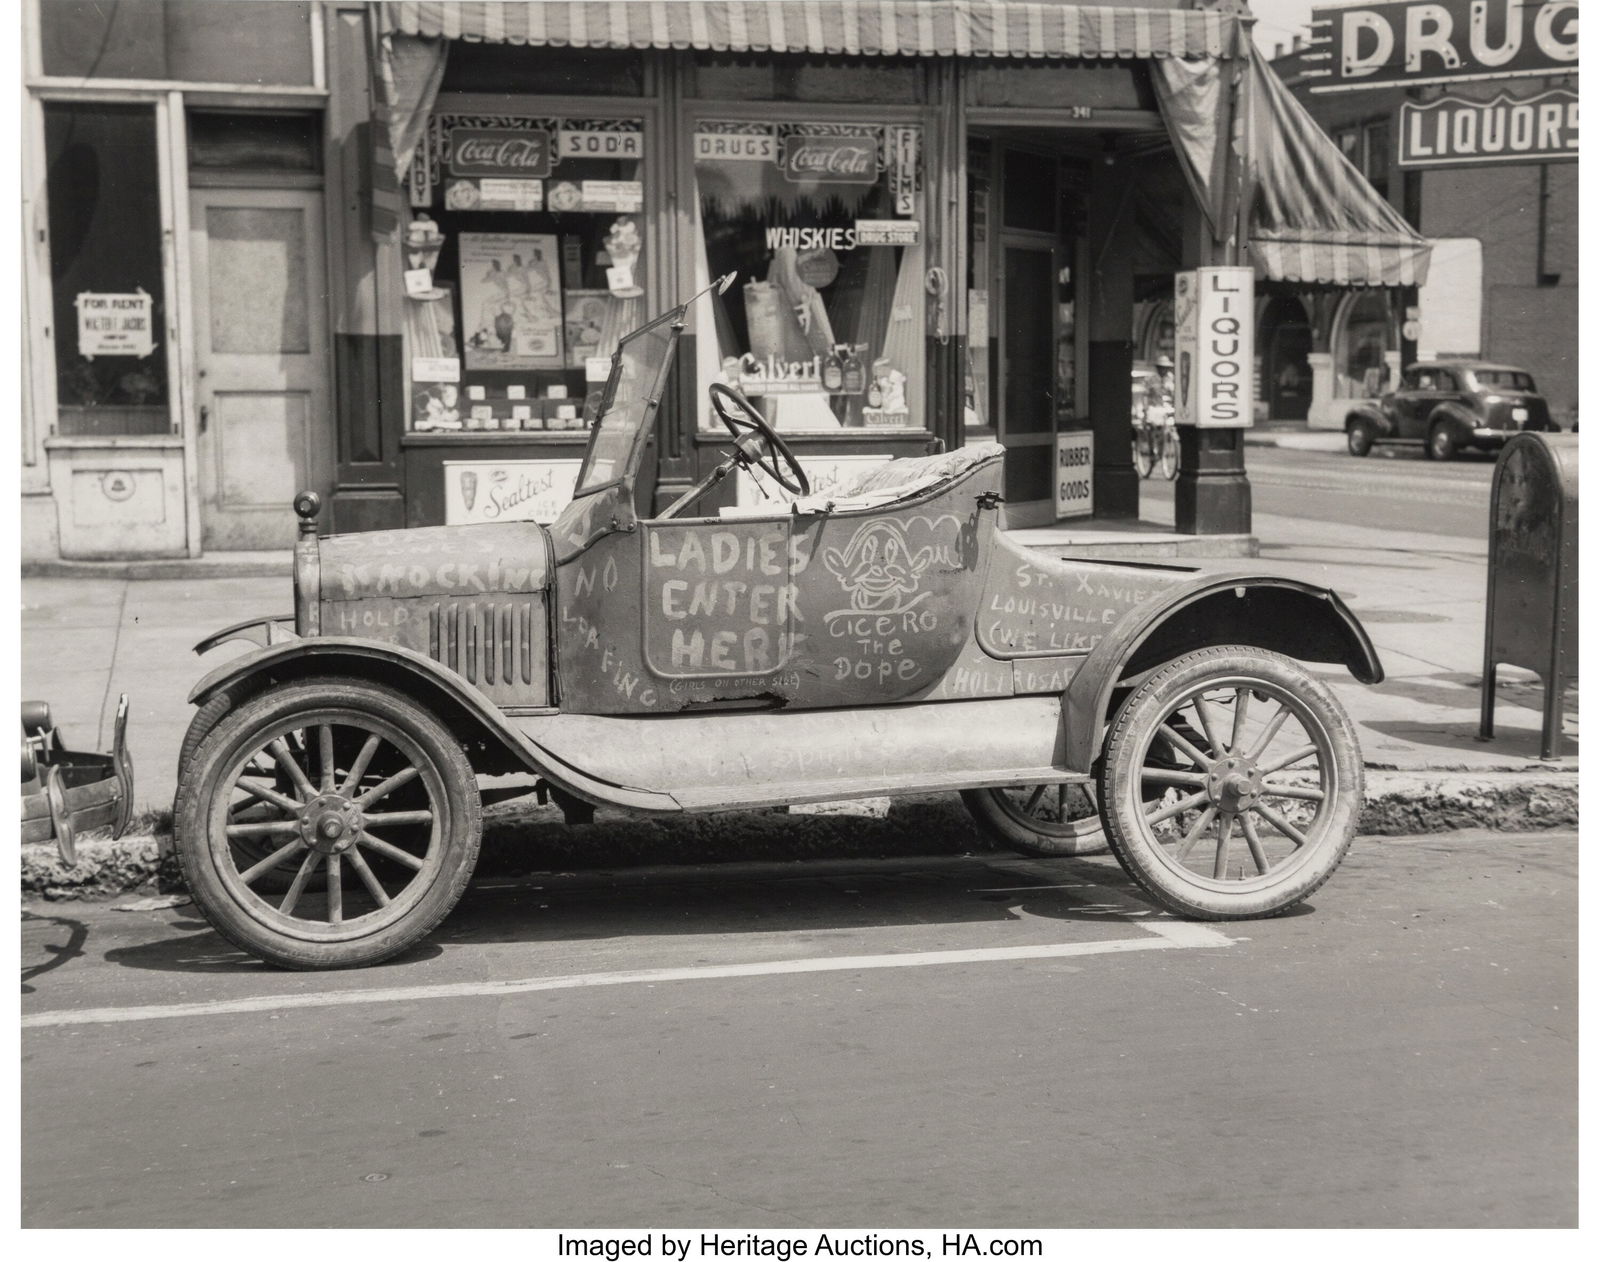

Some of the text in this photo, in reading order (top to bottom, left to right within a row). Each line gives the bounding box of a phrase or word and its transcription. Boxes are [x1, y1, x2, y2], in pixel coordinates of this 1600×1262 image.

[1072, 106, 1091, 119] 341
[570, 136, 636, 152] SODA
[701, 138, 770, 155] DRUGS
[901, 131, 911, 211] FILMS
[765, 228, 857, 250] WHISKIES
[84, 299, 144, 309] FOR RENT
[1210, 275, 1240, 420] LIQUORS
[739, 353, 822, 380] Calvert
[1060, 447, 1090, 468] RUBBER
[483, 467, 553, 519] Sealtest
[1060, 480, 1090, 501] GOODS
[651, 531, 811, 576] LADIES
[574, 555, 618, 597] NO
[1076, 572, 1157, 604] XAVIE
[661, 579, 804, 626] ENTER
[991, 594, 1116, 625] LOUISVILLE
[340, 607, 410, 630] HOLD
[715, 679, 729, 689] ON
